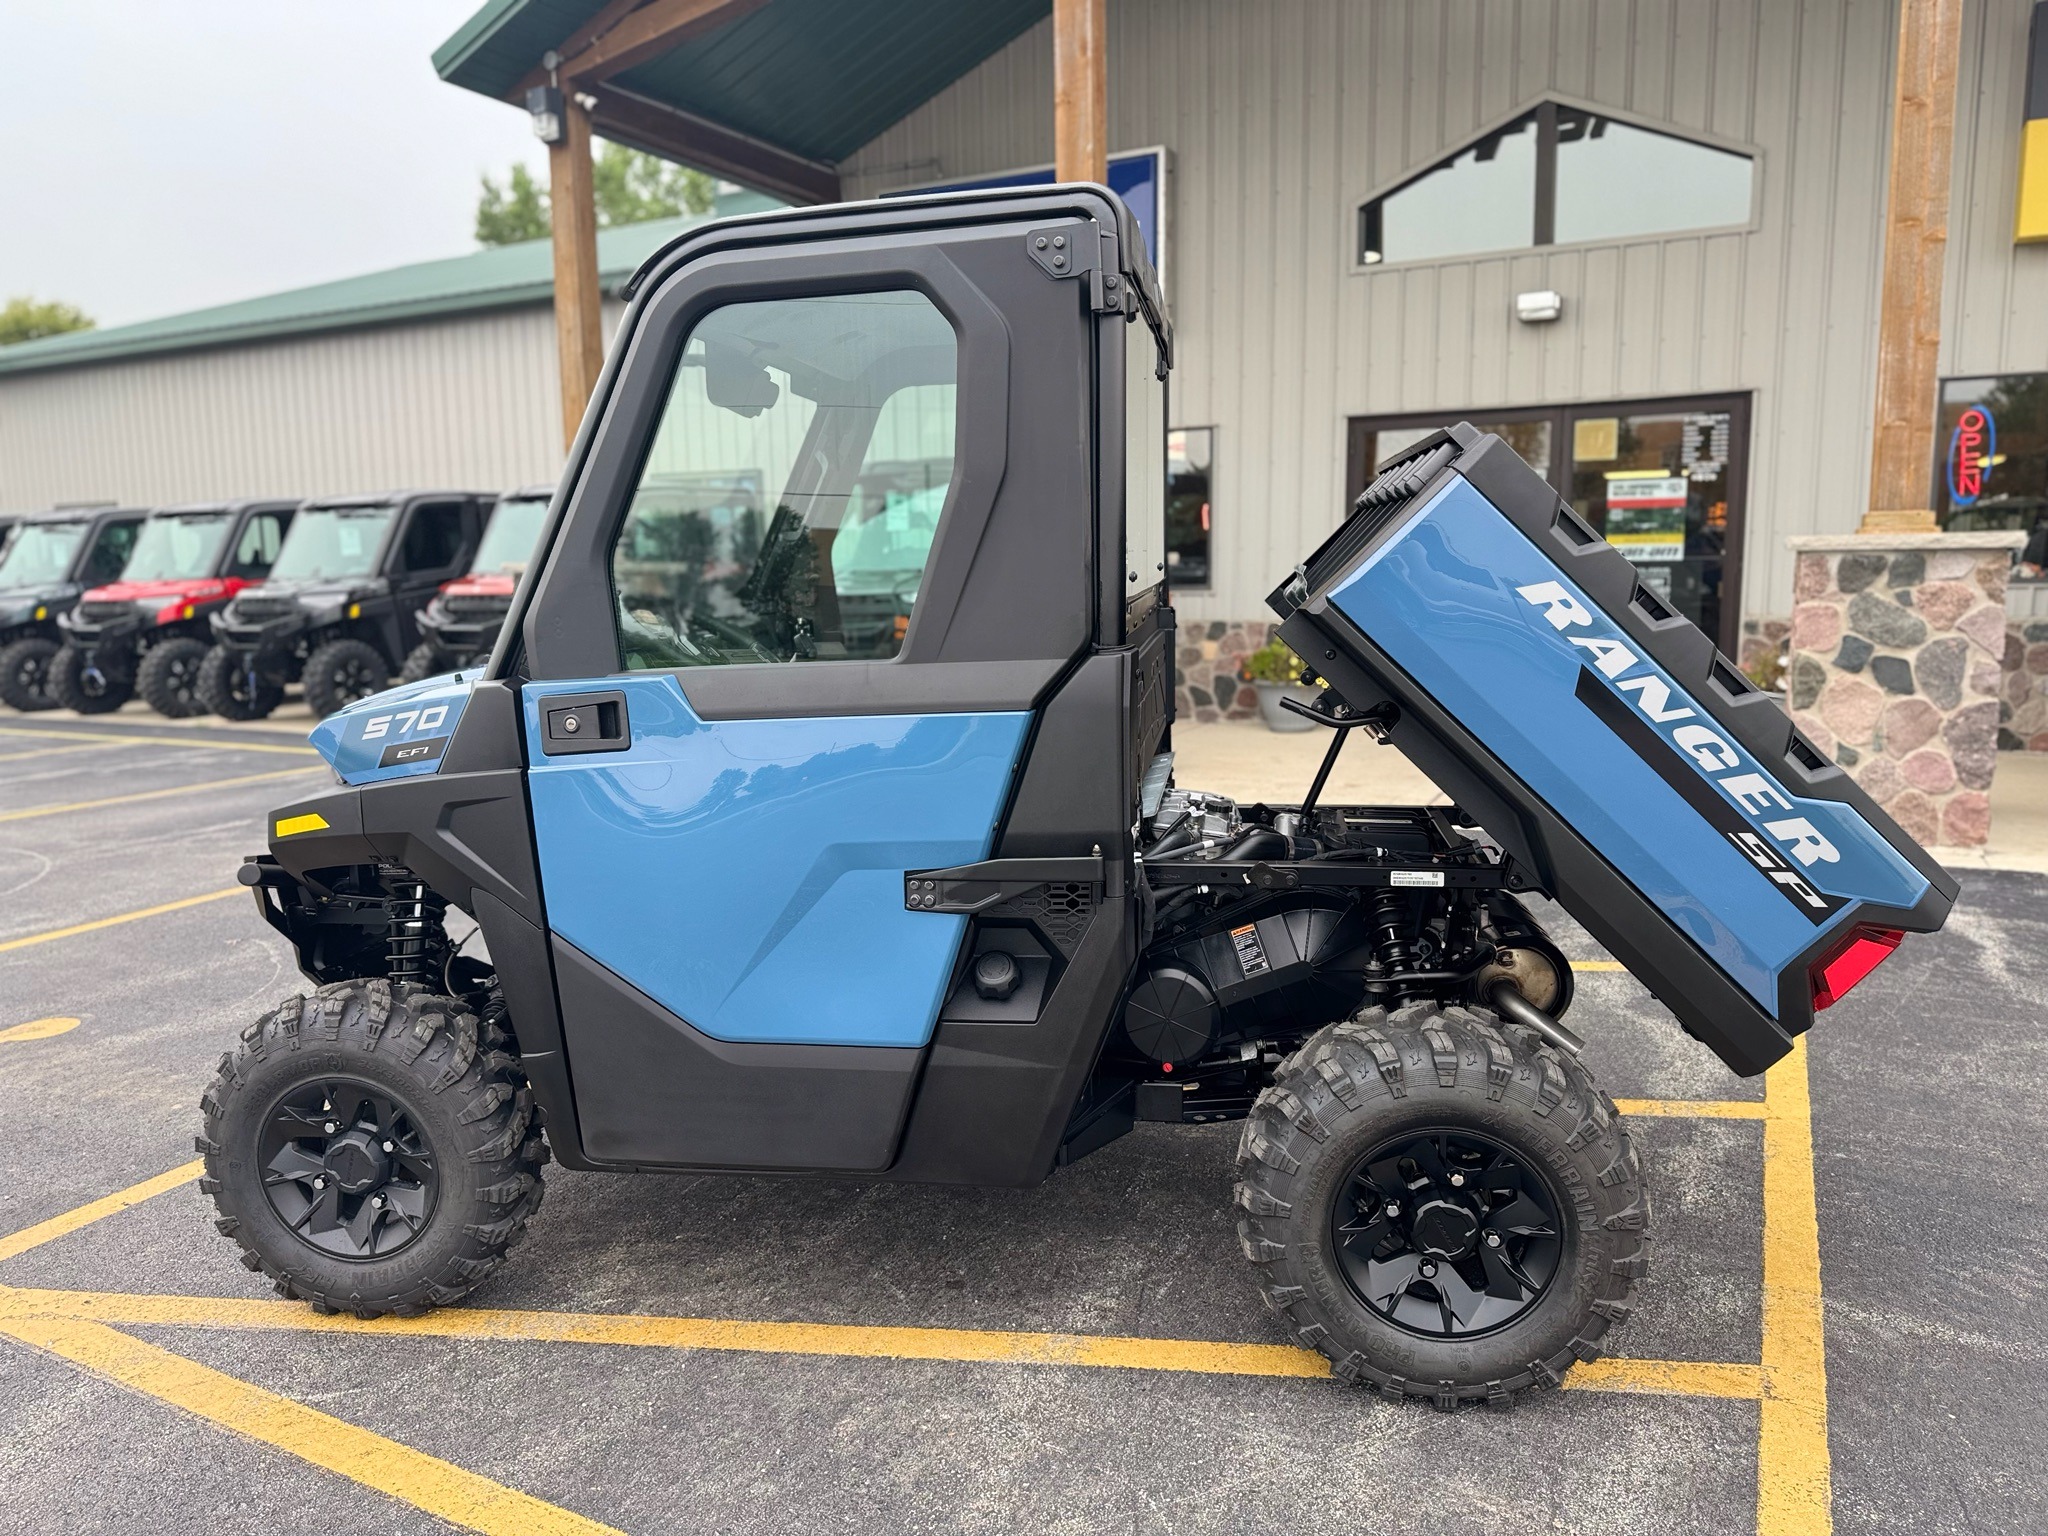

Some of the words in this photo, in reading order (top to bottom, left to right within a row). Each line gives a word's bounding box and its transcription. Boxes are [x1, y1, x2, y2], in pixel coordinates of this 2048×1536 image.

[1958, 409, 1985, 497] OPEN
[362, 705, 449, 740] 570
[396, 746, 430, 759] EFI
[1515, 580, 1841, 868] RANGER
[1727, 832, 1829, 908] SP
[1481, 1106, 1599, 1231] X-TERRAIN
